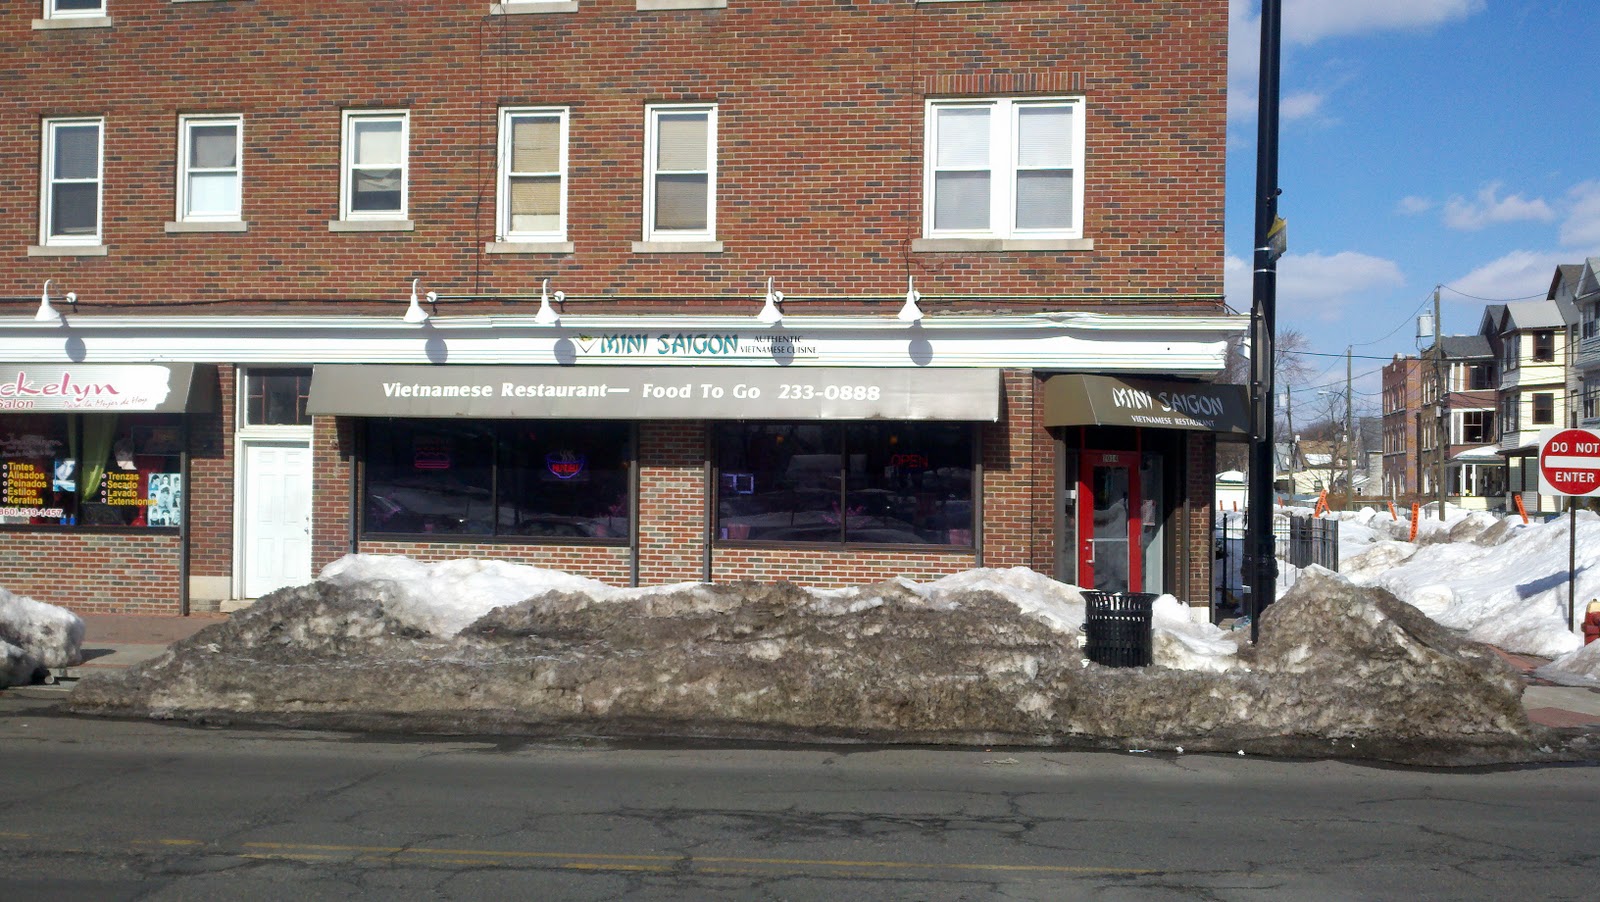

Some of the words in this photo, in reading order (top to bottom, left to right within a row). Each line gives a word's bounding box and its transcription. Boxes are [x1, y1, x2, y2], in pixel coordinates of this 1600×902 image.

[754, 335, 804, 343] AUTHENTIC
[600, 333, 648, 354] MINI
[657, 333, 740, 355] SAIGON
[740, 346, 786, 354] VIETNAMESE
[787, 346, 816, 354] CUISINE
[383, 382, 493, 398] Vietnamese
[643, 383, 692, 399] Food
[701, 384, 724, 399] To
[733, 384, 761, 399] Go
[778, 384, 881, 401] 233-0888
[1112, 387, 1153, 410] MINI
[1158, 391, 1224, 416] SAIGON
[1131, 415, 1173, 425] VIETNAMESE
[1174, 418, 1215, 427] RESTAURANT
[1551, 441, 1568, 453] DO
[1575, 443, 1600, 454] NOT
[8, 462, 34, 471] Tintes
[8, 471, 45, 479] Alisados
[107, 472, 140, 480] Trenzas
[1555, 471, 1595, 483] ENTER
[8, 478, 47, 488] Peinados
[107, 480, 138, 489] Secado
[8, 487, 37, 496] Estilos
[107, 489, 138, 497] Lavado
[8, 496, 43, 505] Keratina
[107, 497, 158, 506] Extensiones
